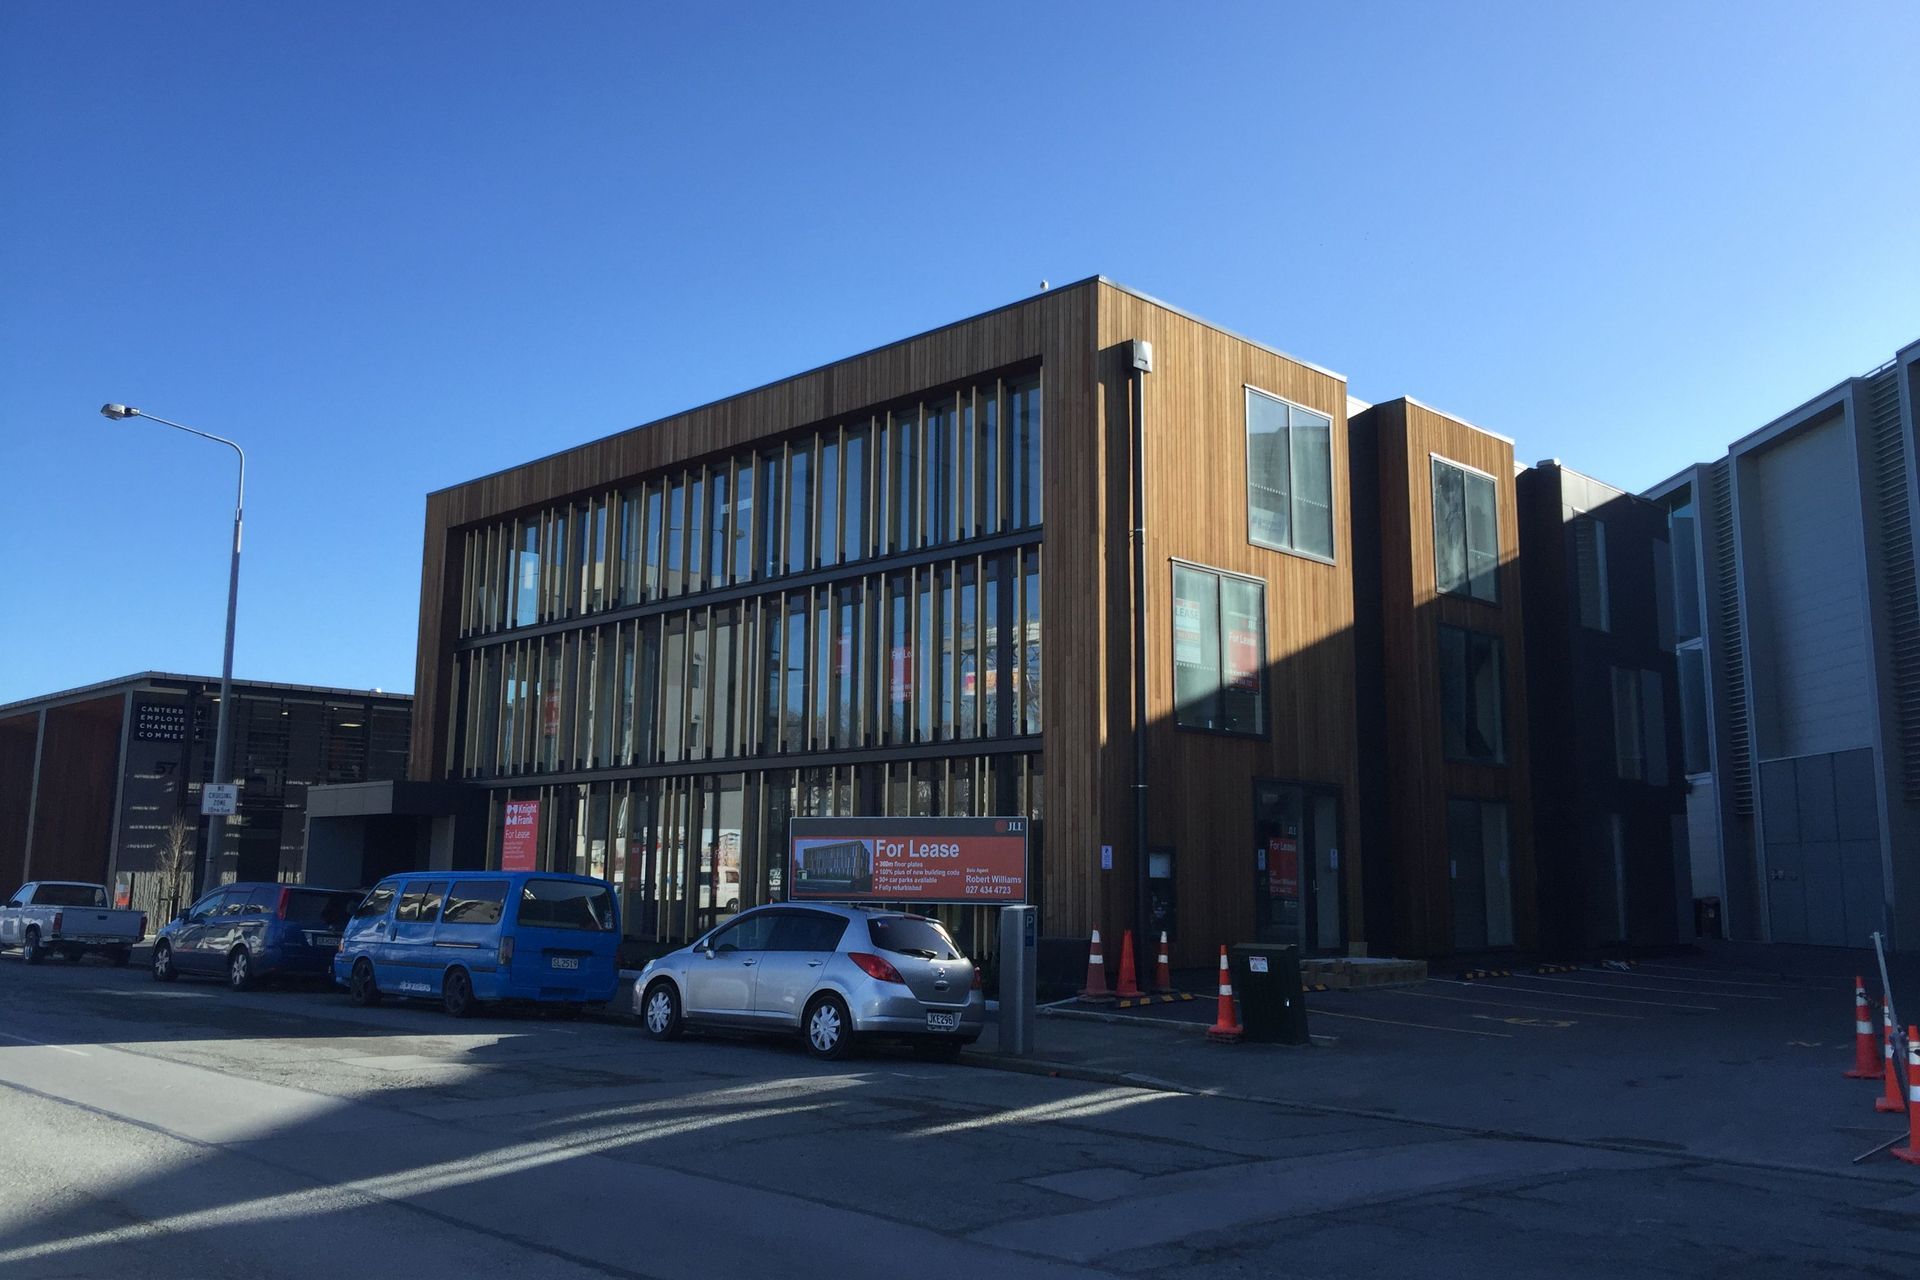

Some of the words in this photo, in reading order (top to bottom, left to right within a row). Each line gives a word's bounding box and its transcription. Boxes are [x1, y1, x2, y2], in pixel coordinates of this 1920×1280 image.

[156, 761, 178, 775] 57
[519, 803, 537, 815] Knight
[518, 815, 533, 825] Frank
[1008, 822, 1024, 831] JLL
[506, 829, 514, 839] For
[515, 829, 531, 839] Lease
[876, 840, 904, 857] For
[909, 840, 960, 858] Lease
[925, 869, 946, 877] building
[966, 875, 990, 884] Robert
[991, 875, 1022, 884] Williams
[966, 886, 979, 894] 027
[980, 886, 993, 894] 434
[994, 886, 1012, 894] 4723
[1026, 915, 1034, 928] P
[929, 1014, 953, 1025] JKE296
